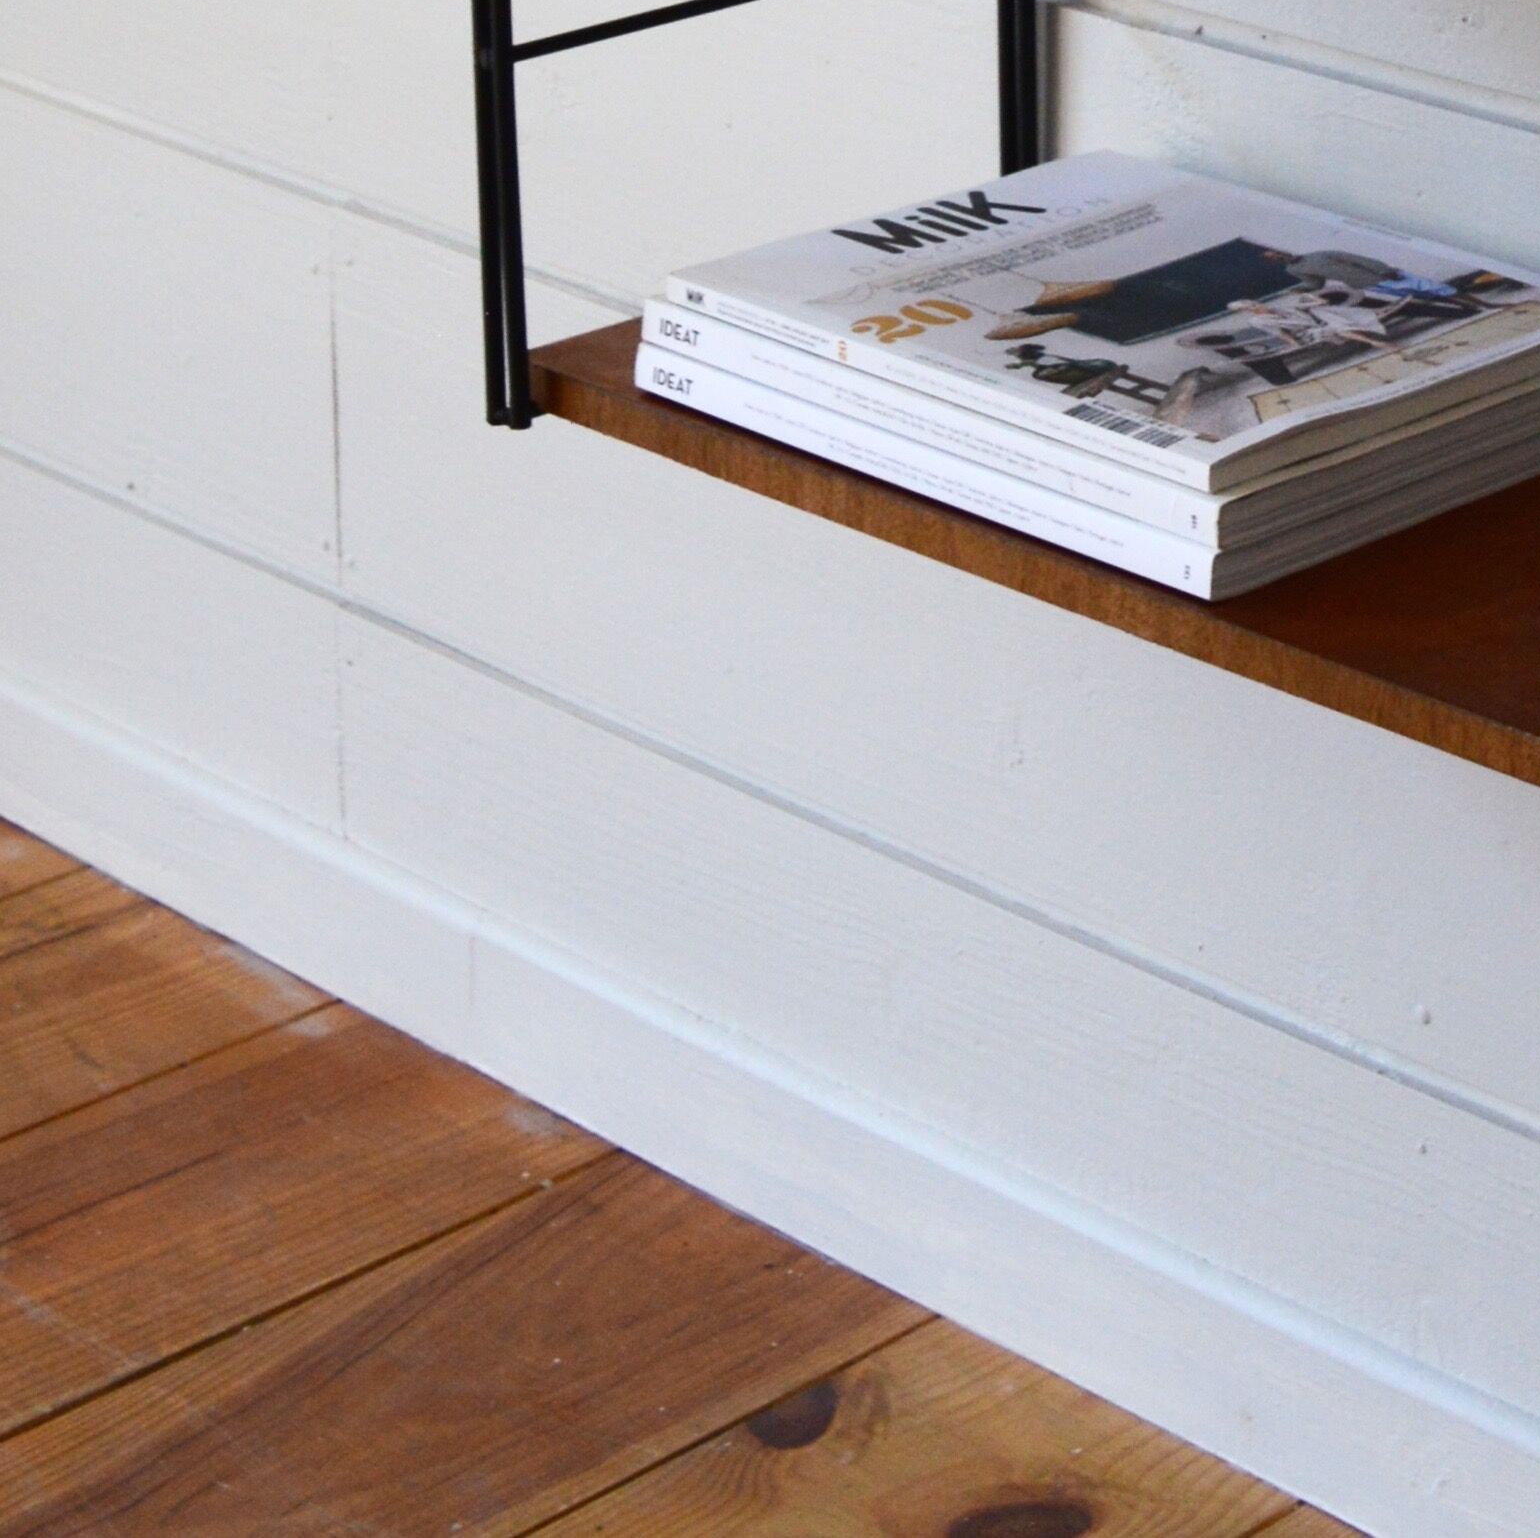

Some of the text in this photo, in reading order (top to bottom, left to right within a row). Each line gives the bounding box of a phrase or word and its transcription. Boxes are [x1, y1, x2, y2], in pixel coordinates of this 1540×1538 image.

[659, 318, 700, 346] IDEAT
[852, 299, 973, 343] 20
[652, 367, 693, 395] IDEAT
